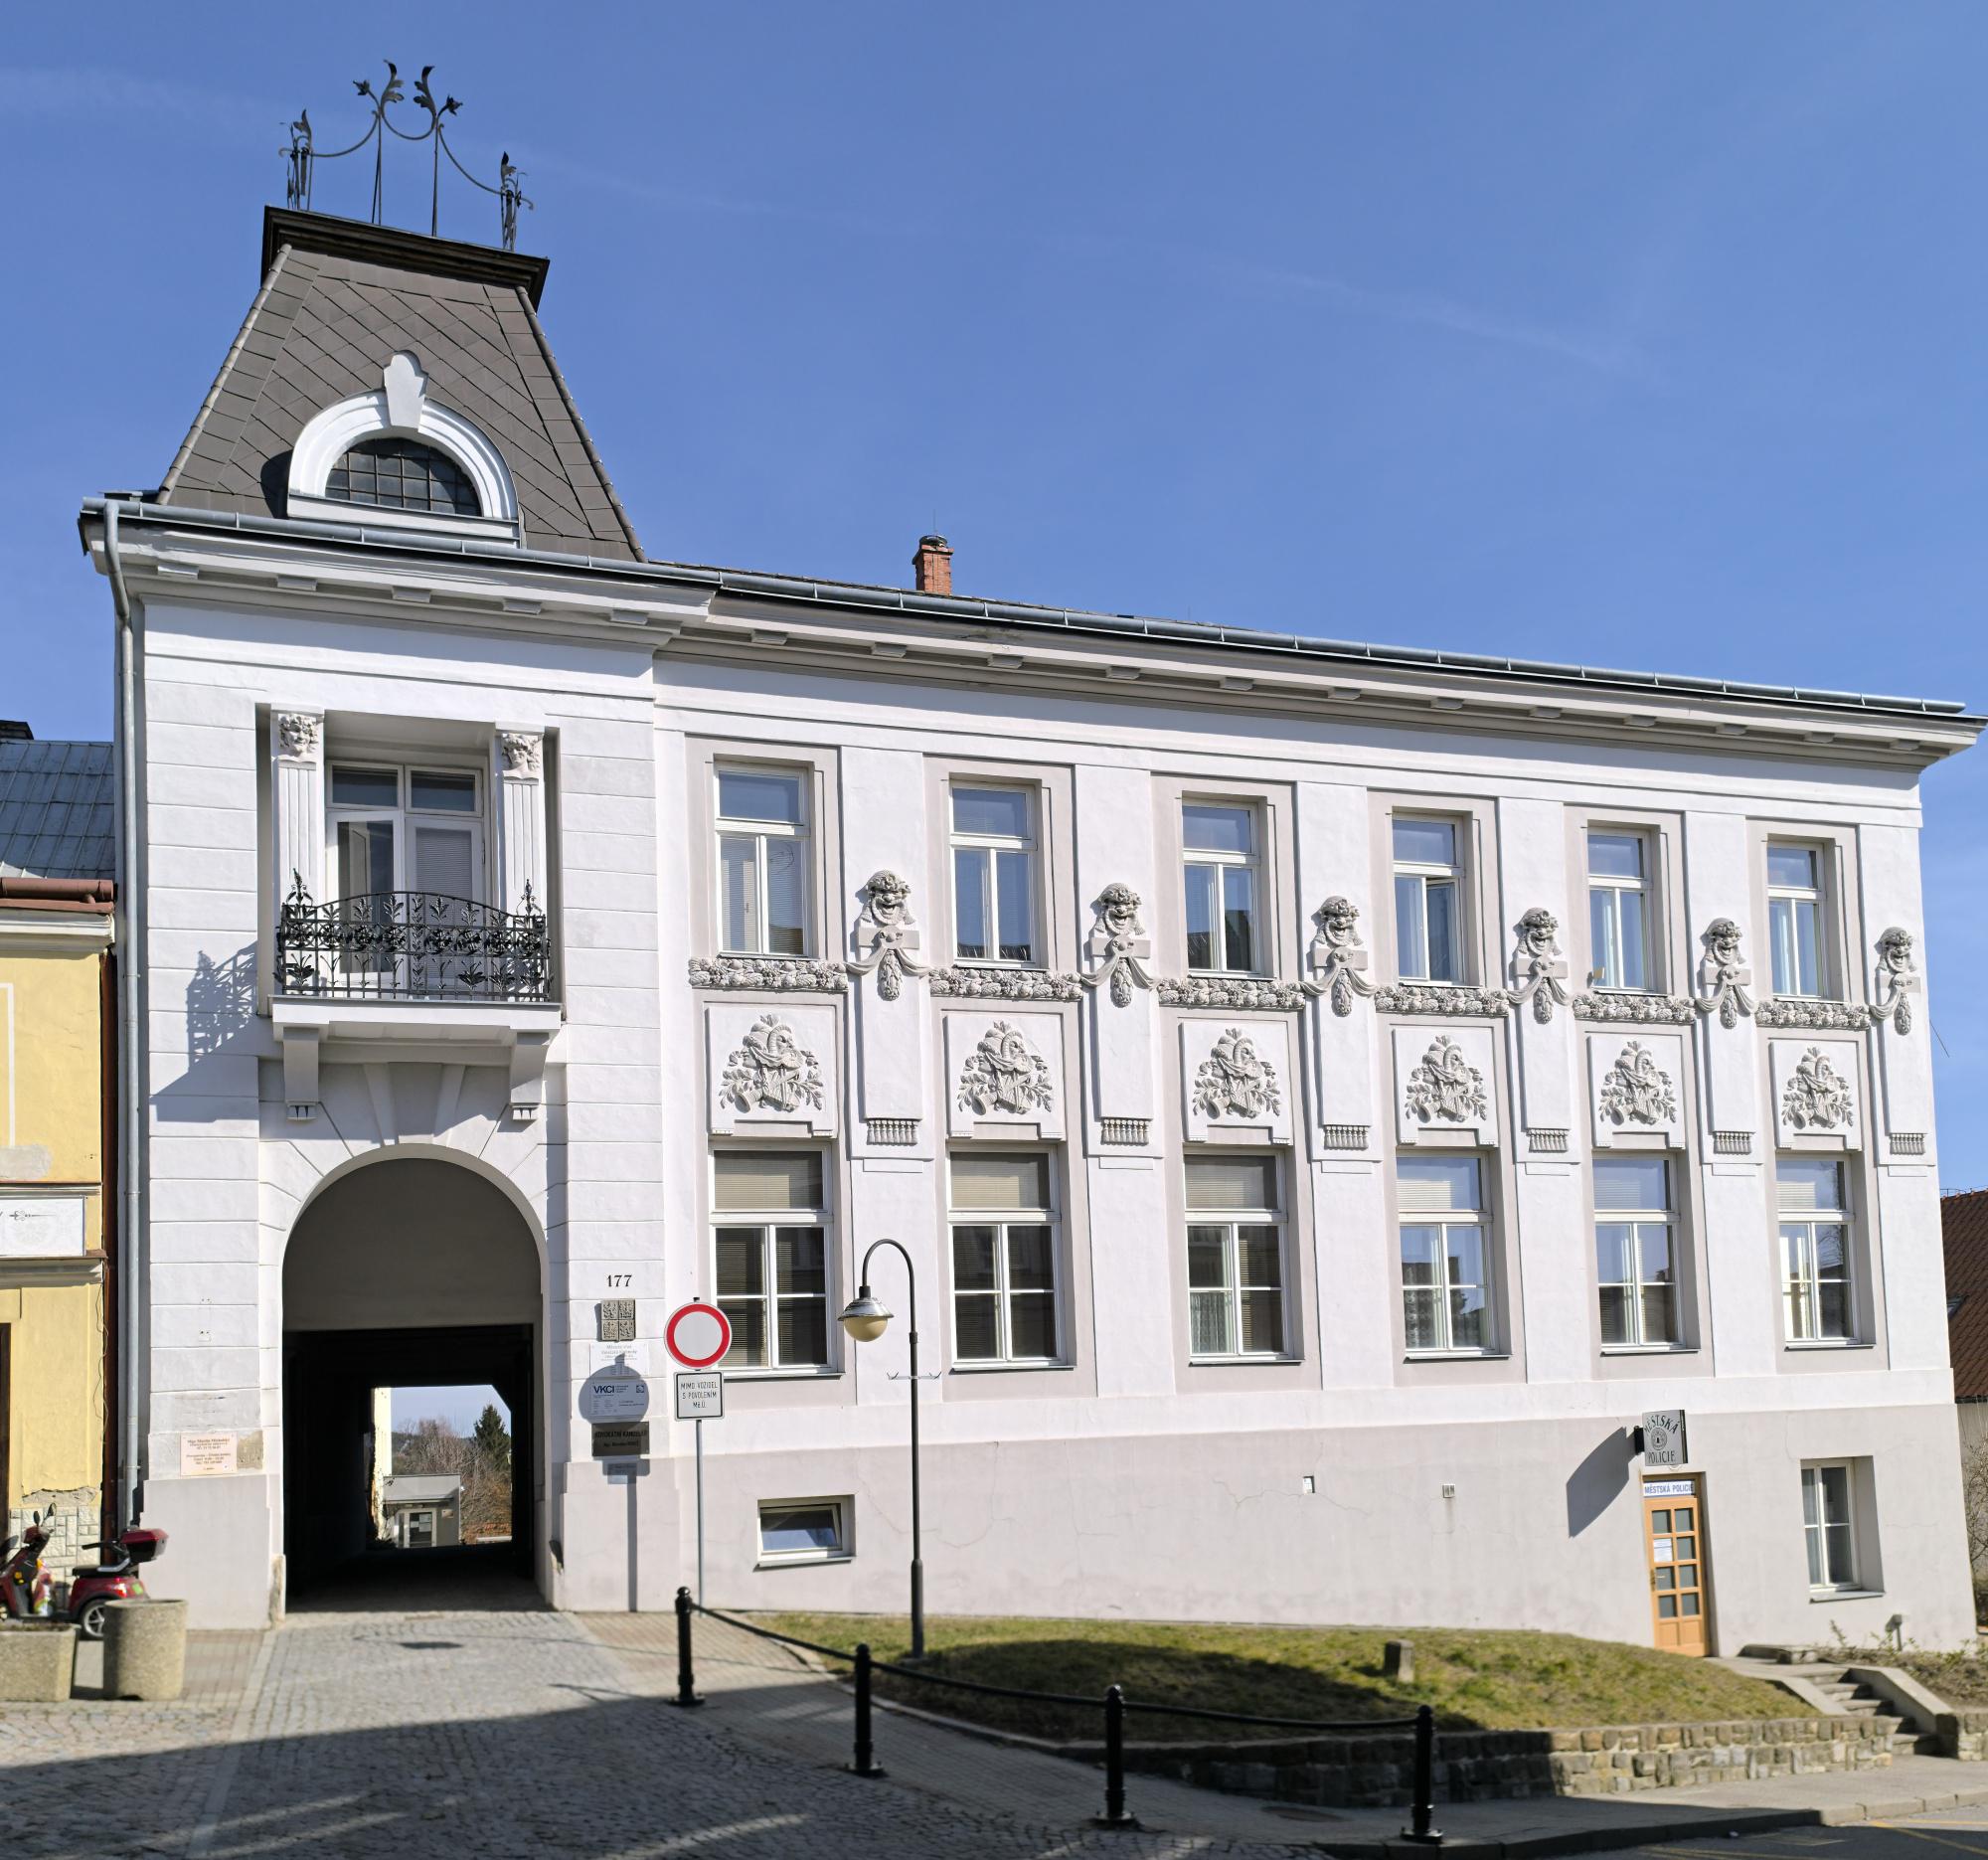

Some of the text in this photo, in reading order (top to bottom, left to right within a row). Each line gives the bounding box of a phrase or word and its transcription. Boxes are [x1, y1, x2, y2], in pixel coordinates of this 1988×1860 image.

[607, 1274, 632, 1287] 177
[593, 1385, 614, 1394] VKCI
[688, 1390, 717, 1400] POVOLENÍM
[1644, 1415, 1680, 1435] MĚSTSKÁ
[1648, 1450, 1675, 1464] POLICIE
[1644, 1482, 1694, 1494] MĚSTSKÁ POLICIE
